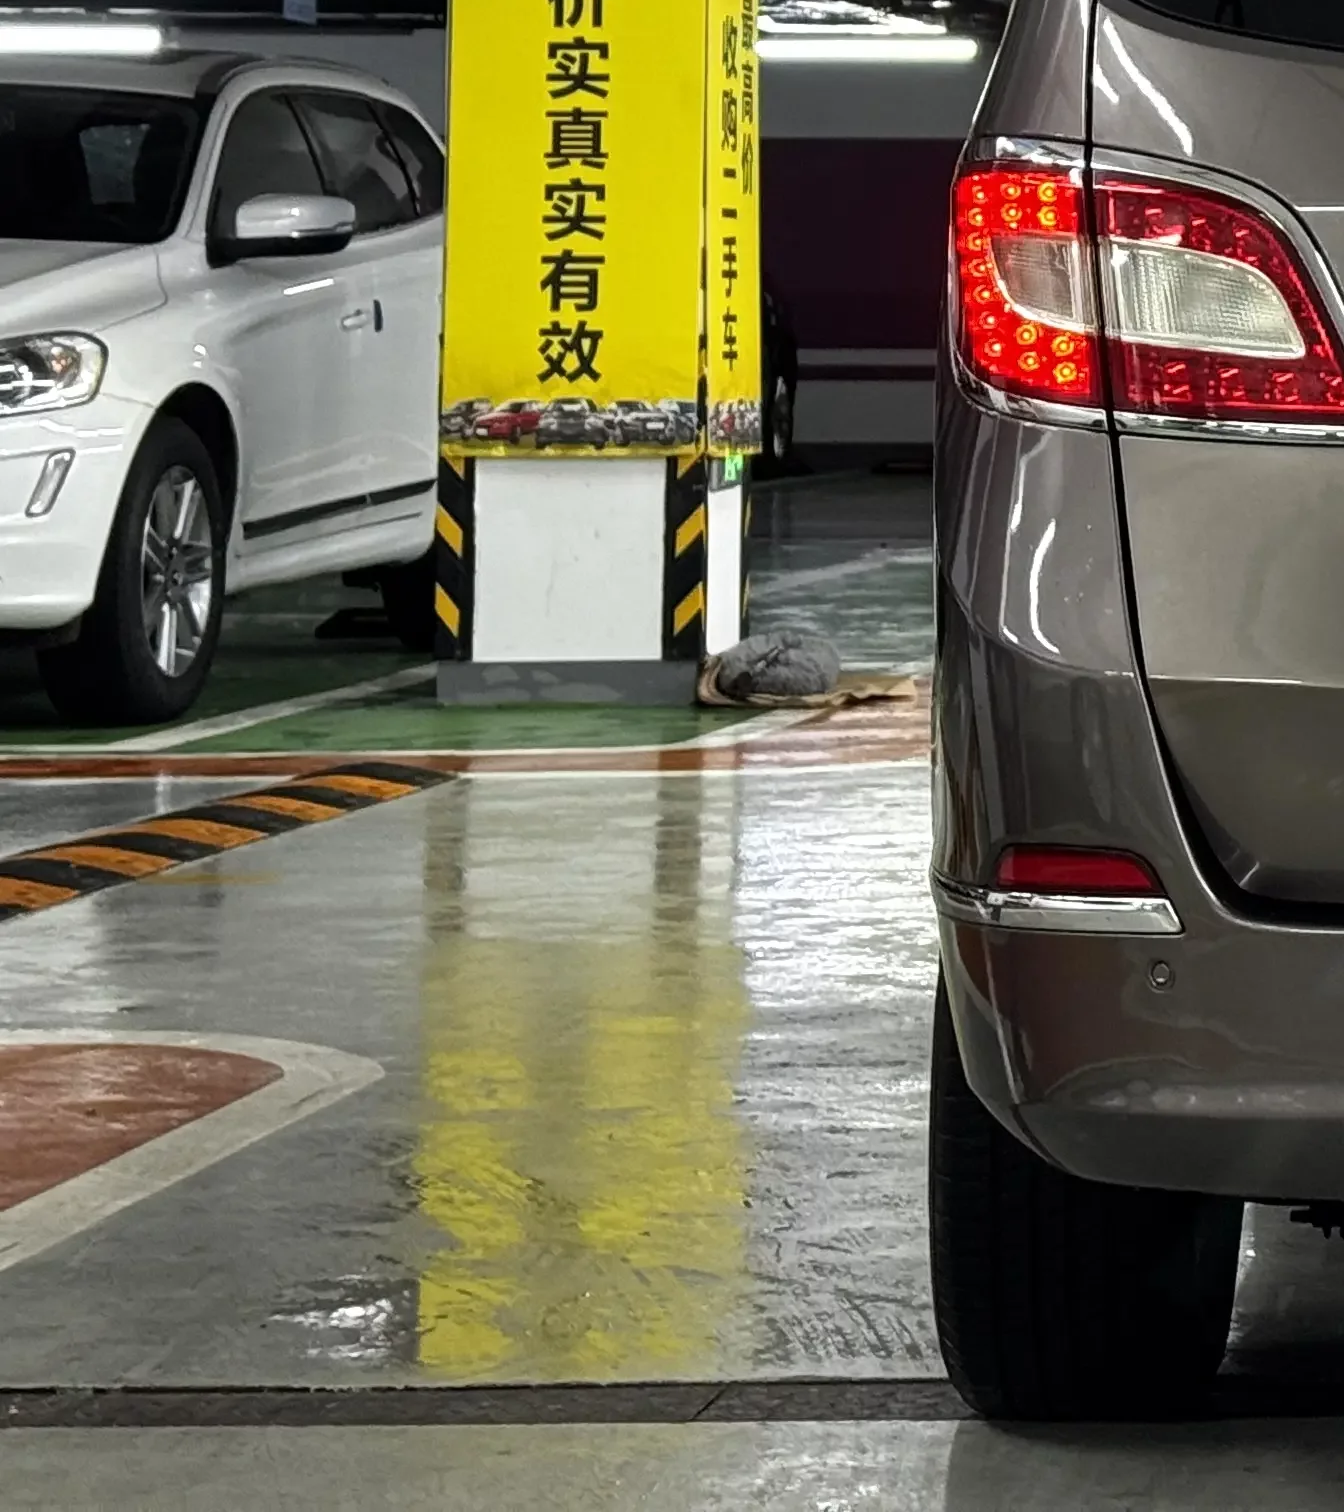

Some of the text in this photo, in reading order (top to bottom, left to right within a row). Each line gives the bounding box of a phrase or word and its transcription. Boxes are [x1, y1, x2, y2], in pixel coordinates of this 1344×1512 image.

[721, 15, 739, 373] 收购二手车
